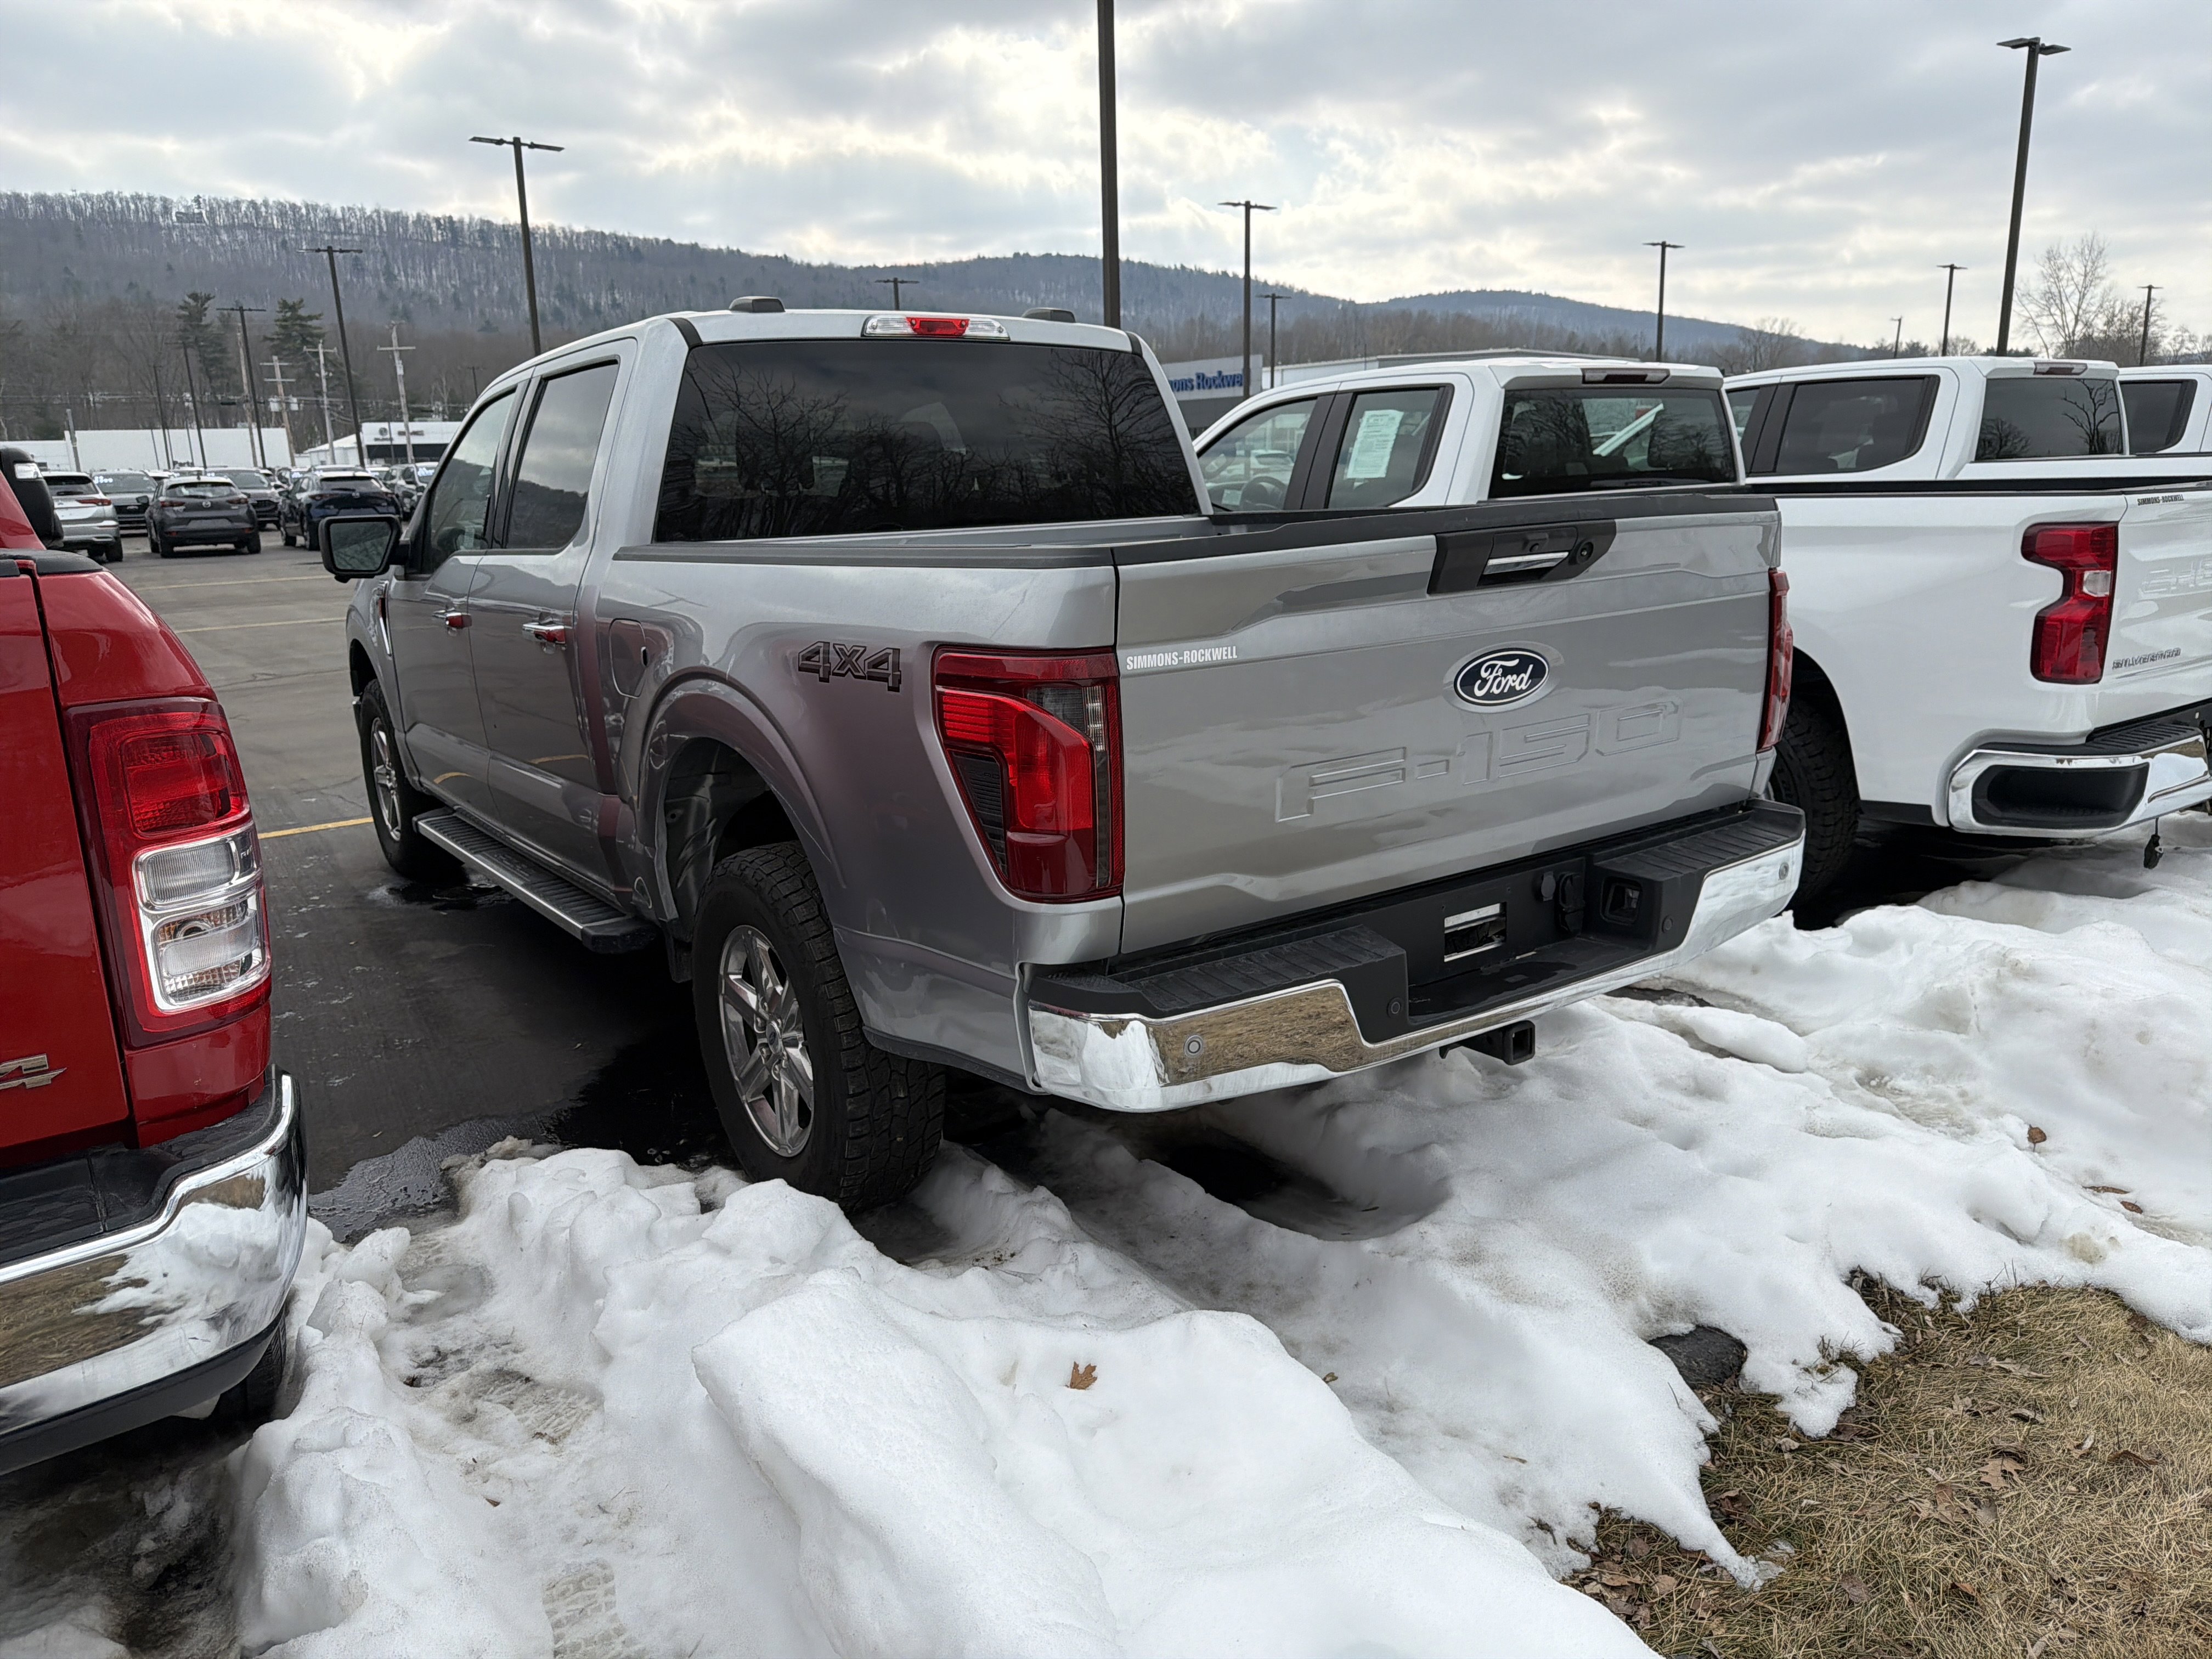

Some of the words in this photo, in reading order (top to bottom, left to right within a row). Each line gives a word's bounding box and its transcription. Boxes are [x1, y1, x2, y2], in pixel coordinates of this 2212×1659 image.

[1195, 370, 1244, 390] Rockwe
[1126, 646, 1238, 670] SIMMONS-ROCKWELL
[1474, 658, 1534, 697] Ford
[1275, 698, 1682, 822] F-150
